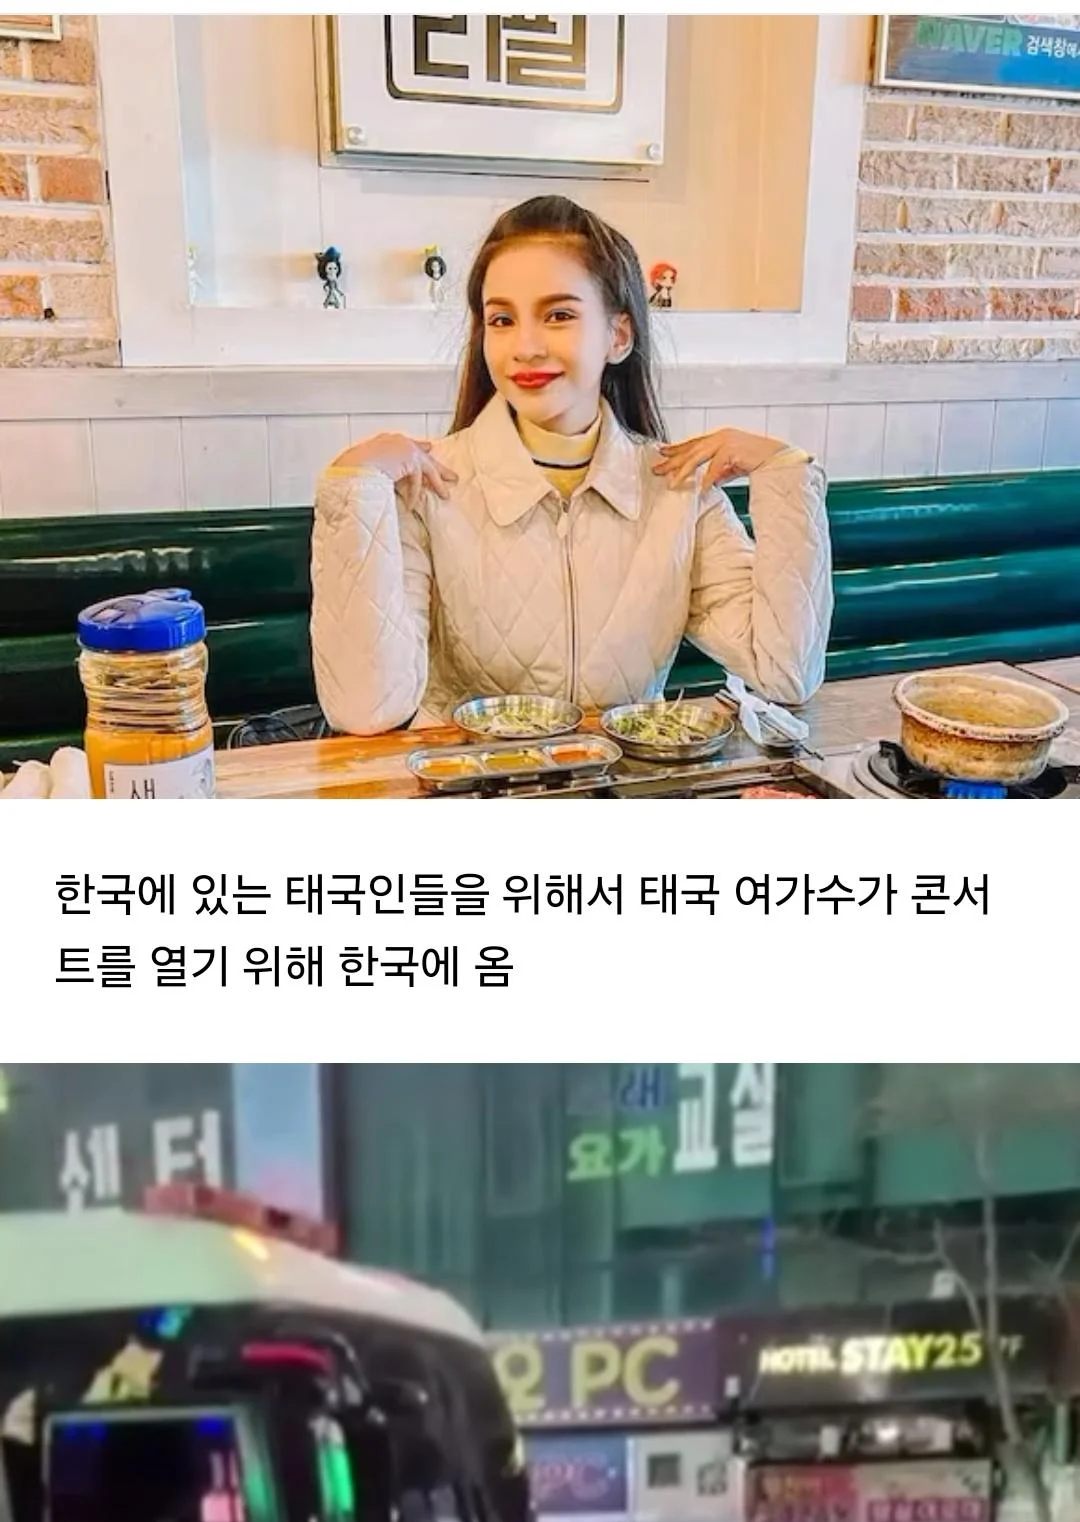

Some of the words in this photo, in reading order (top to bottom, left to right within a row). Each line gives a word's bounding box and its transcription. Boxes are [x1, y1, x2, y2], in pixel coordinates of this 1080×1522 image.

[916, 16, 1023, 57] NAVER
[1026, 35, 1080, 59] 검색창에
[567, 1123, 667, 1183] 요가
[571, 1336, 680, 1409] PC
[759, 1345, 836, 1374] HOTEL
[841, 1332, 983, 1377] STAY25
